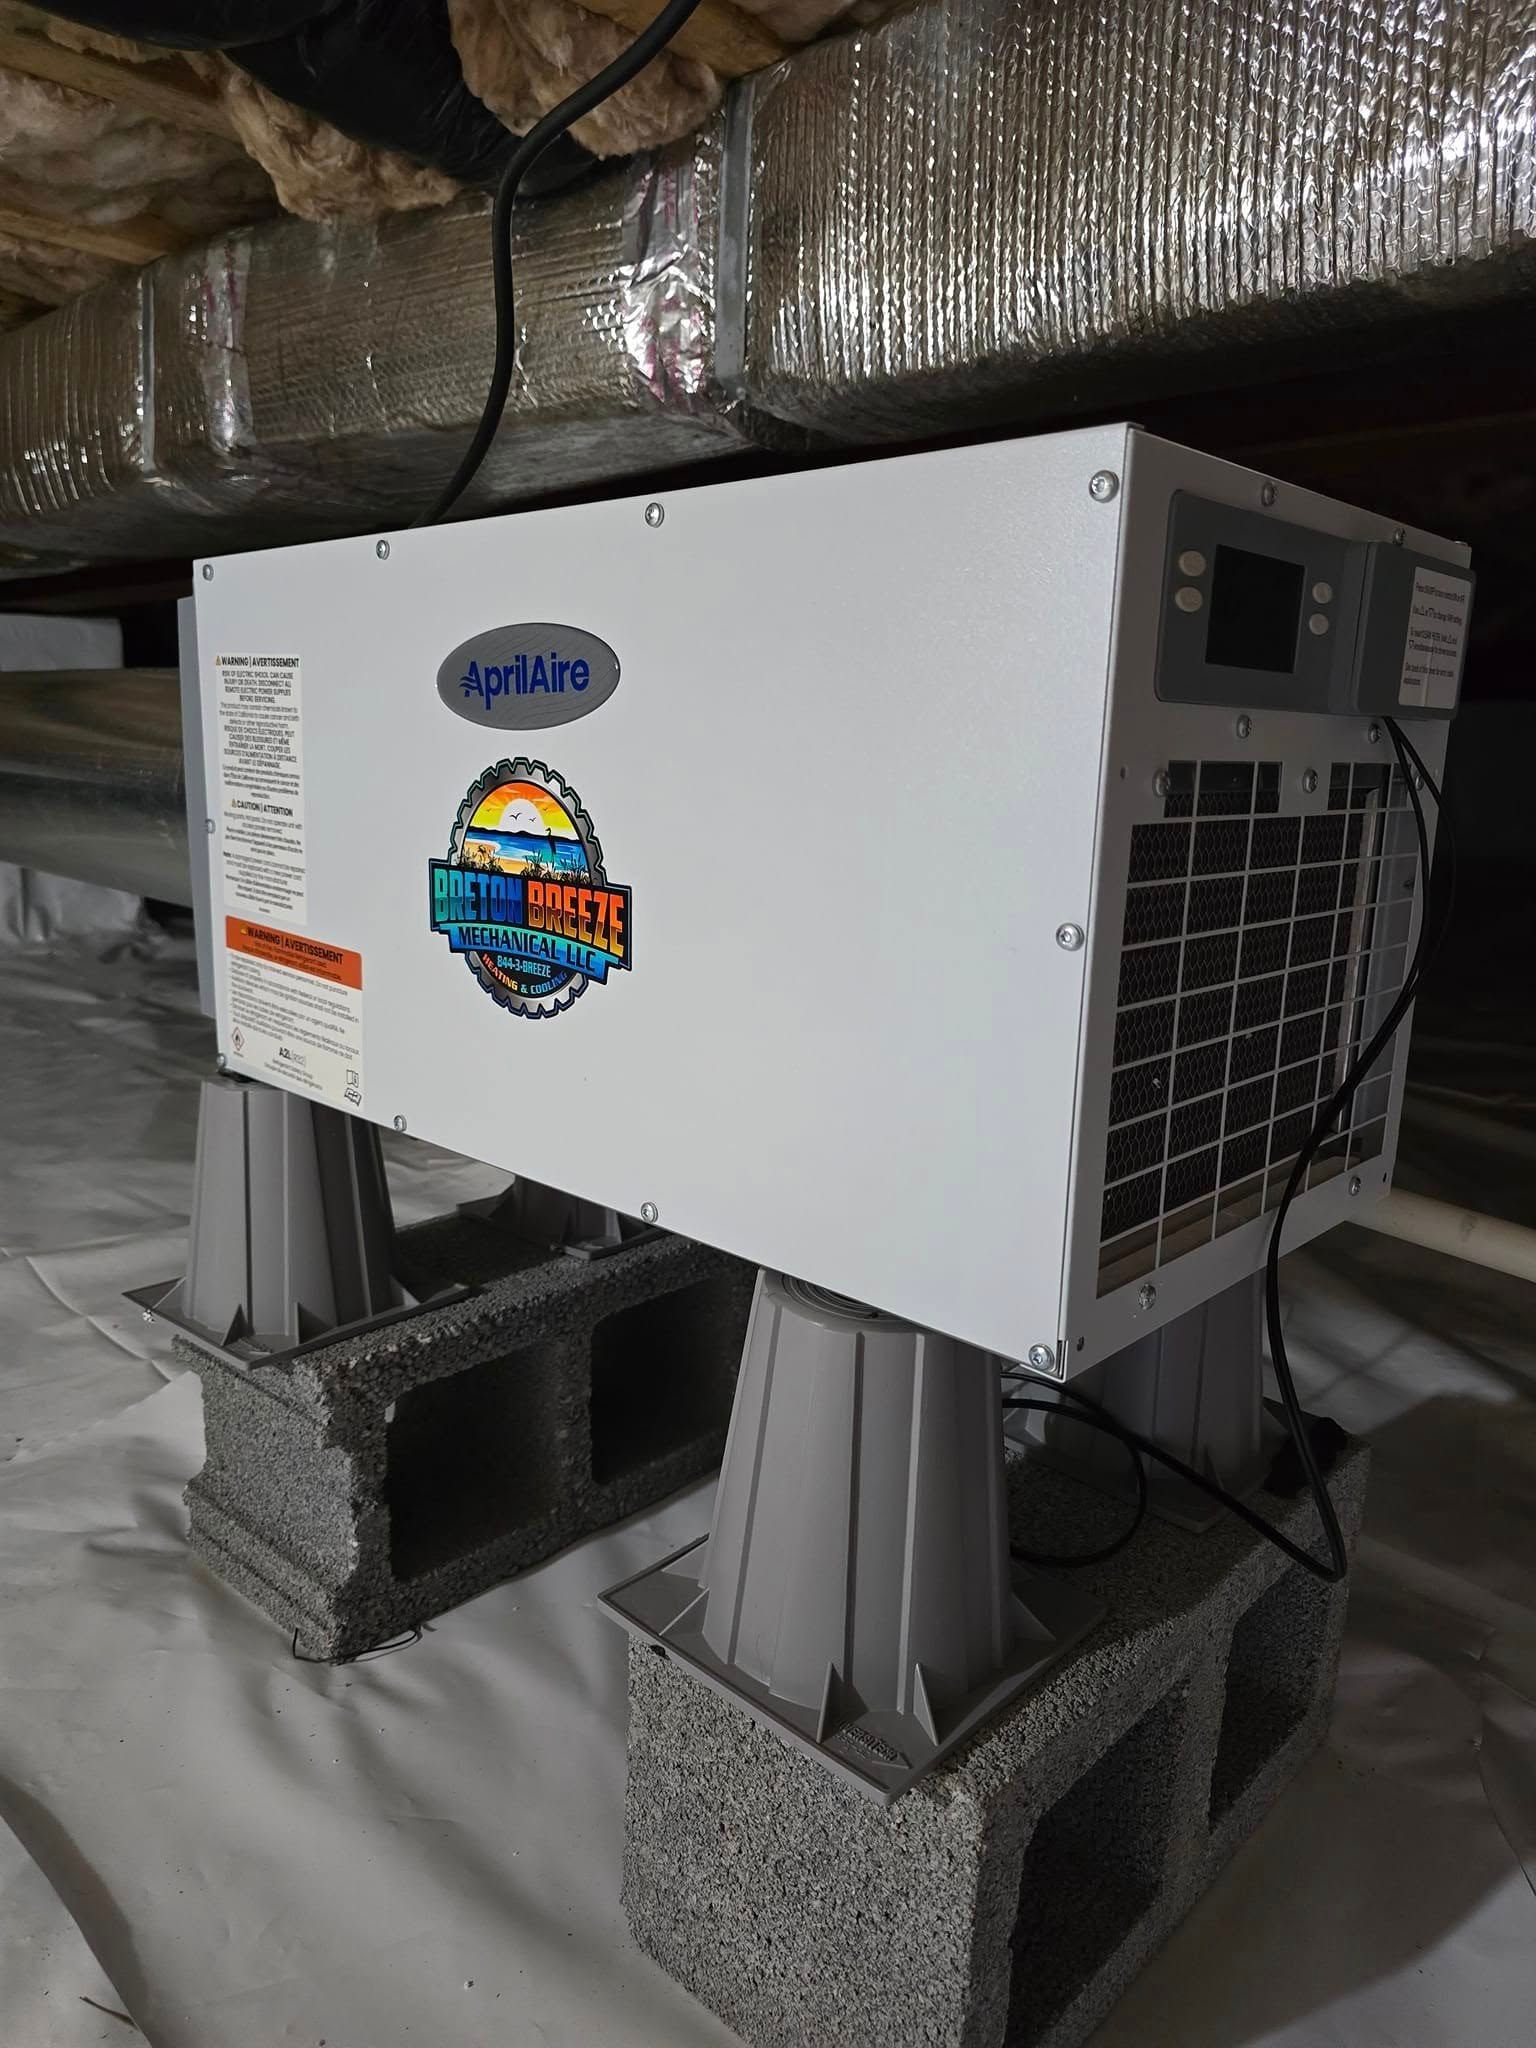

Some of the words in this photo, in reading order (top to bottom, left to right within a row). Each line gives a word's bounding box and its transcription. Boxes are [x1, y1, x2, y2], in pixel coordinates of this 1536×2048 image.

[222, 656, 249, 667] WARNING
[252, 657, 299, 668] AVERTISSEMENT
[460, 652, 590, 711] AprilAire
[237, 800, 260, 811] CAUTION
[263, 804, 294, 817] ATTENTION
[434, 868, 524, 924] BRETON
[528, 880, 624, 957] BREEZE
[247, 927, 281, 945] WARNING
[285, 939, 343, 964] AVERTISSEMENT
[458, 926, 560, 961] MECHANICAL
[567, 943, 596, 972] LLC
[482, 953, 518, 991] HEATING
[520, 984, 528, 994] &
